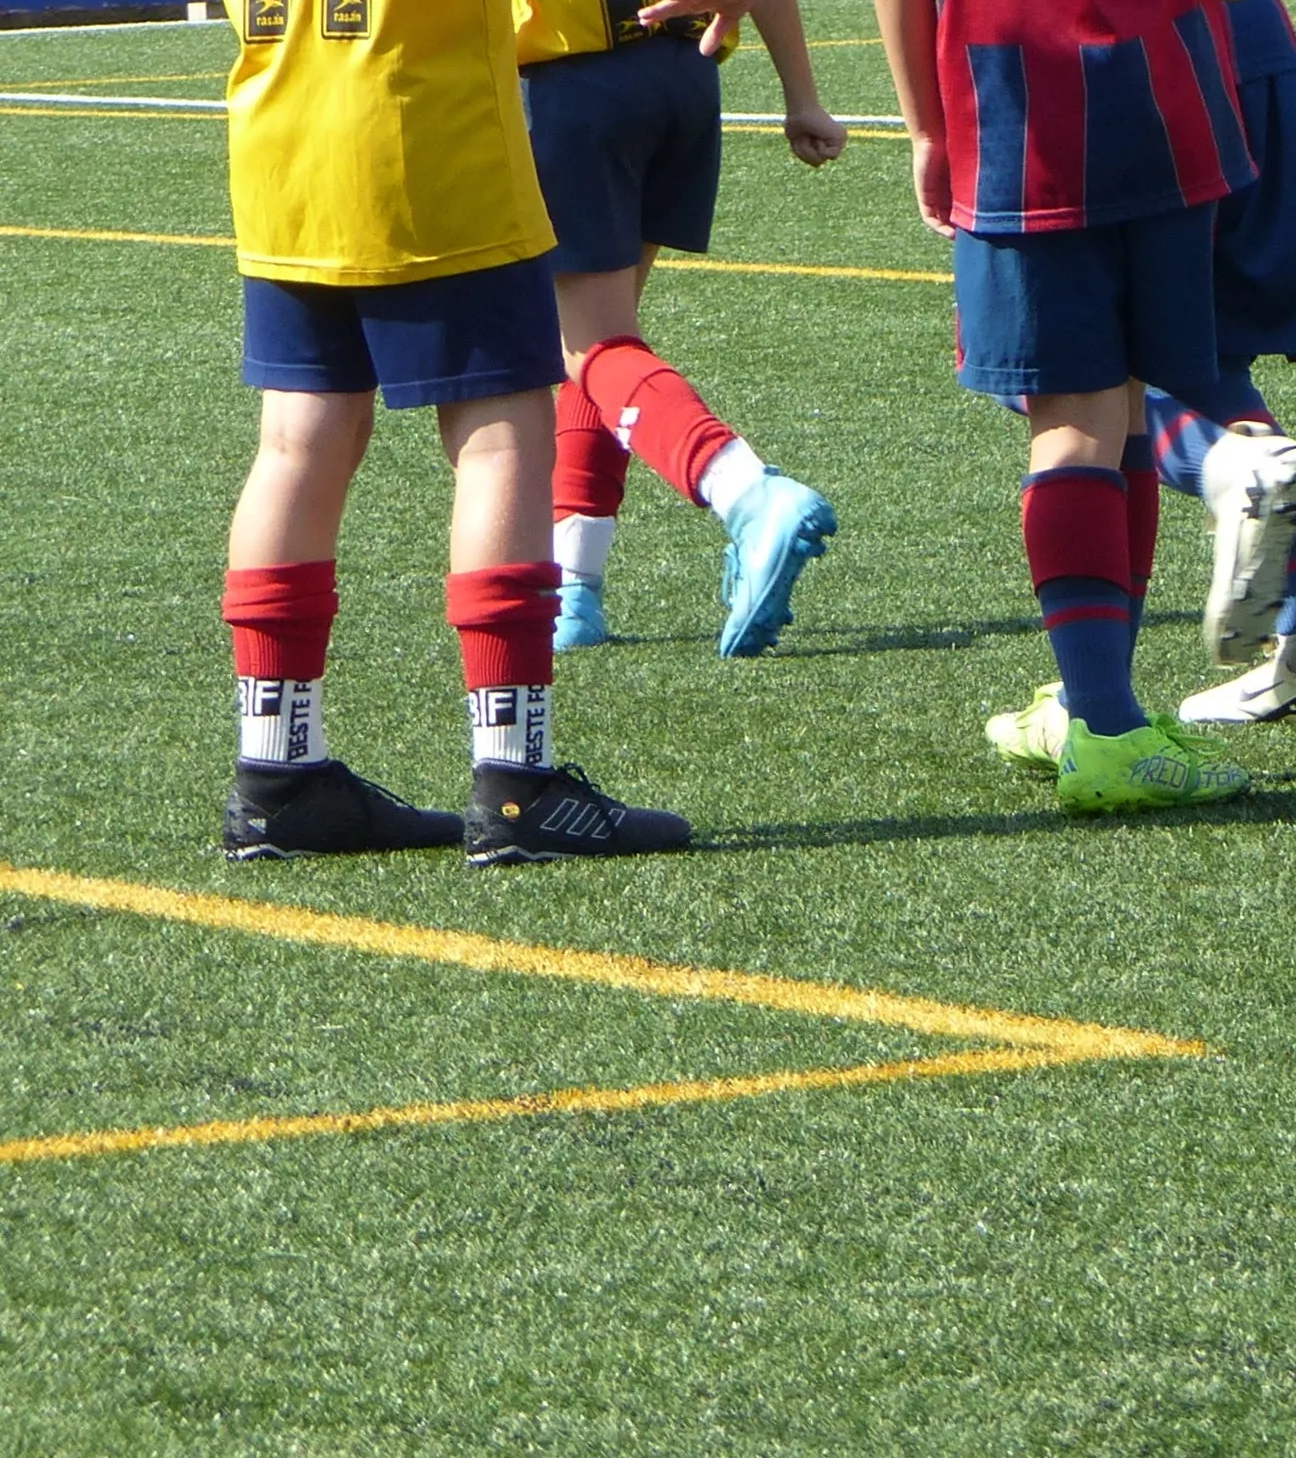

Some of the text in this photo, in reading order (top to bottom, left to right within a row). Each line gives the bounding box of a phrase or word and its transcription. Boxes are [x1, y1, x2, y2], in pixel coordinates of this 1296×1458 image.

[287, 699, 311, 761] BESTE
[525, 708, 546, 765] BESTE
[1130, 754, 1243, 789] PREDTOR
